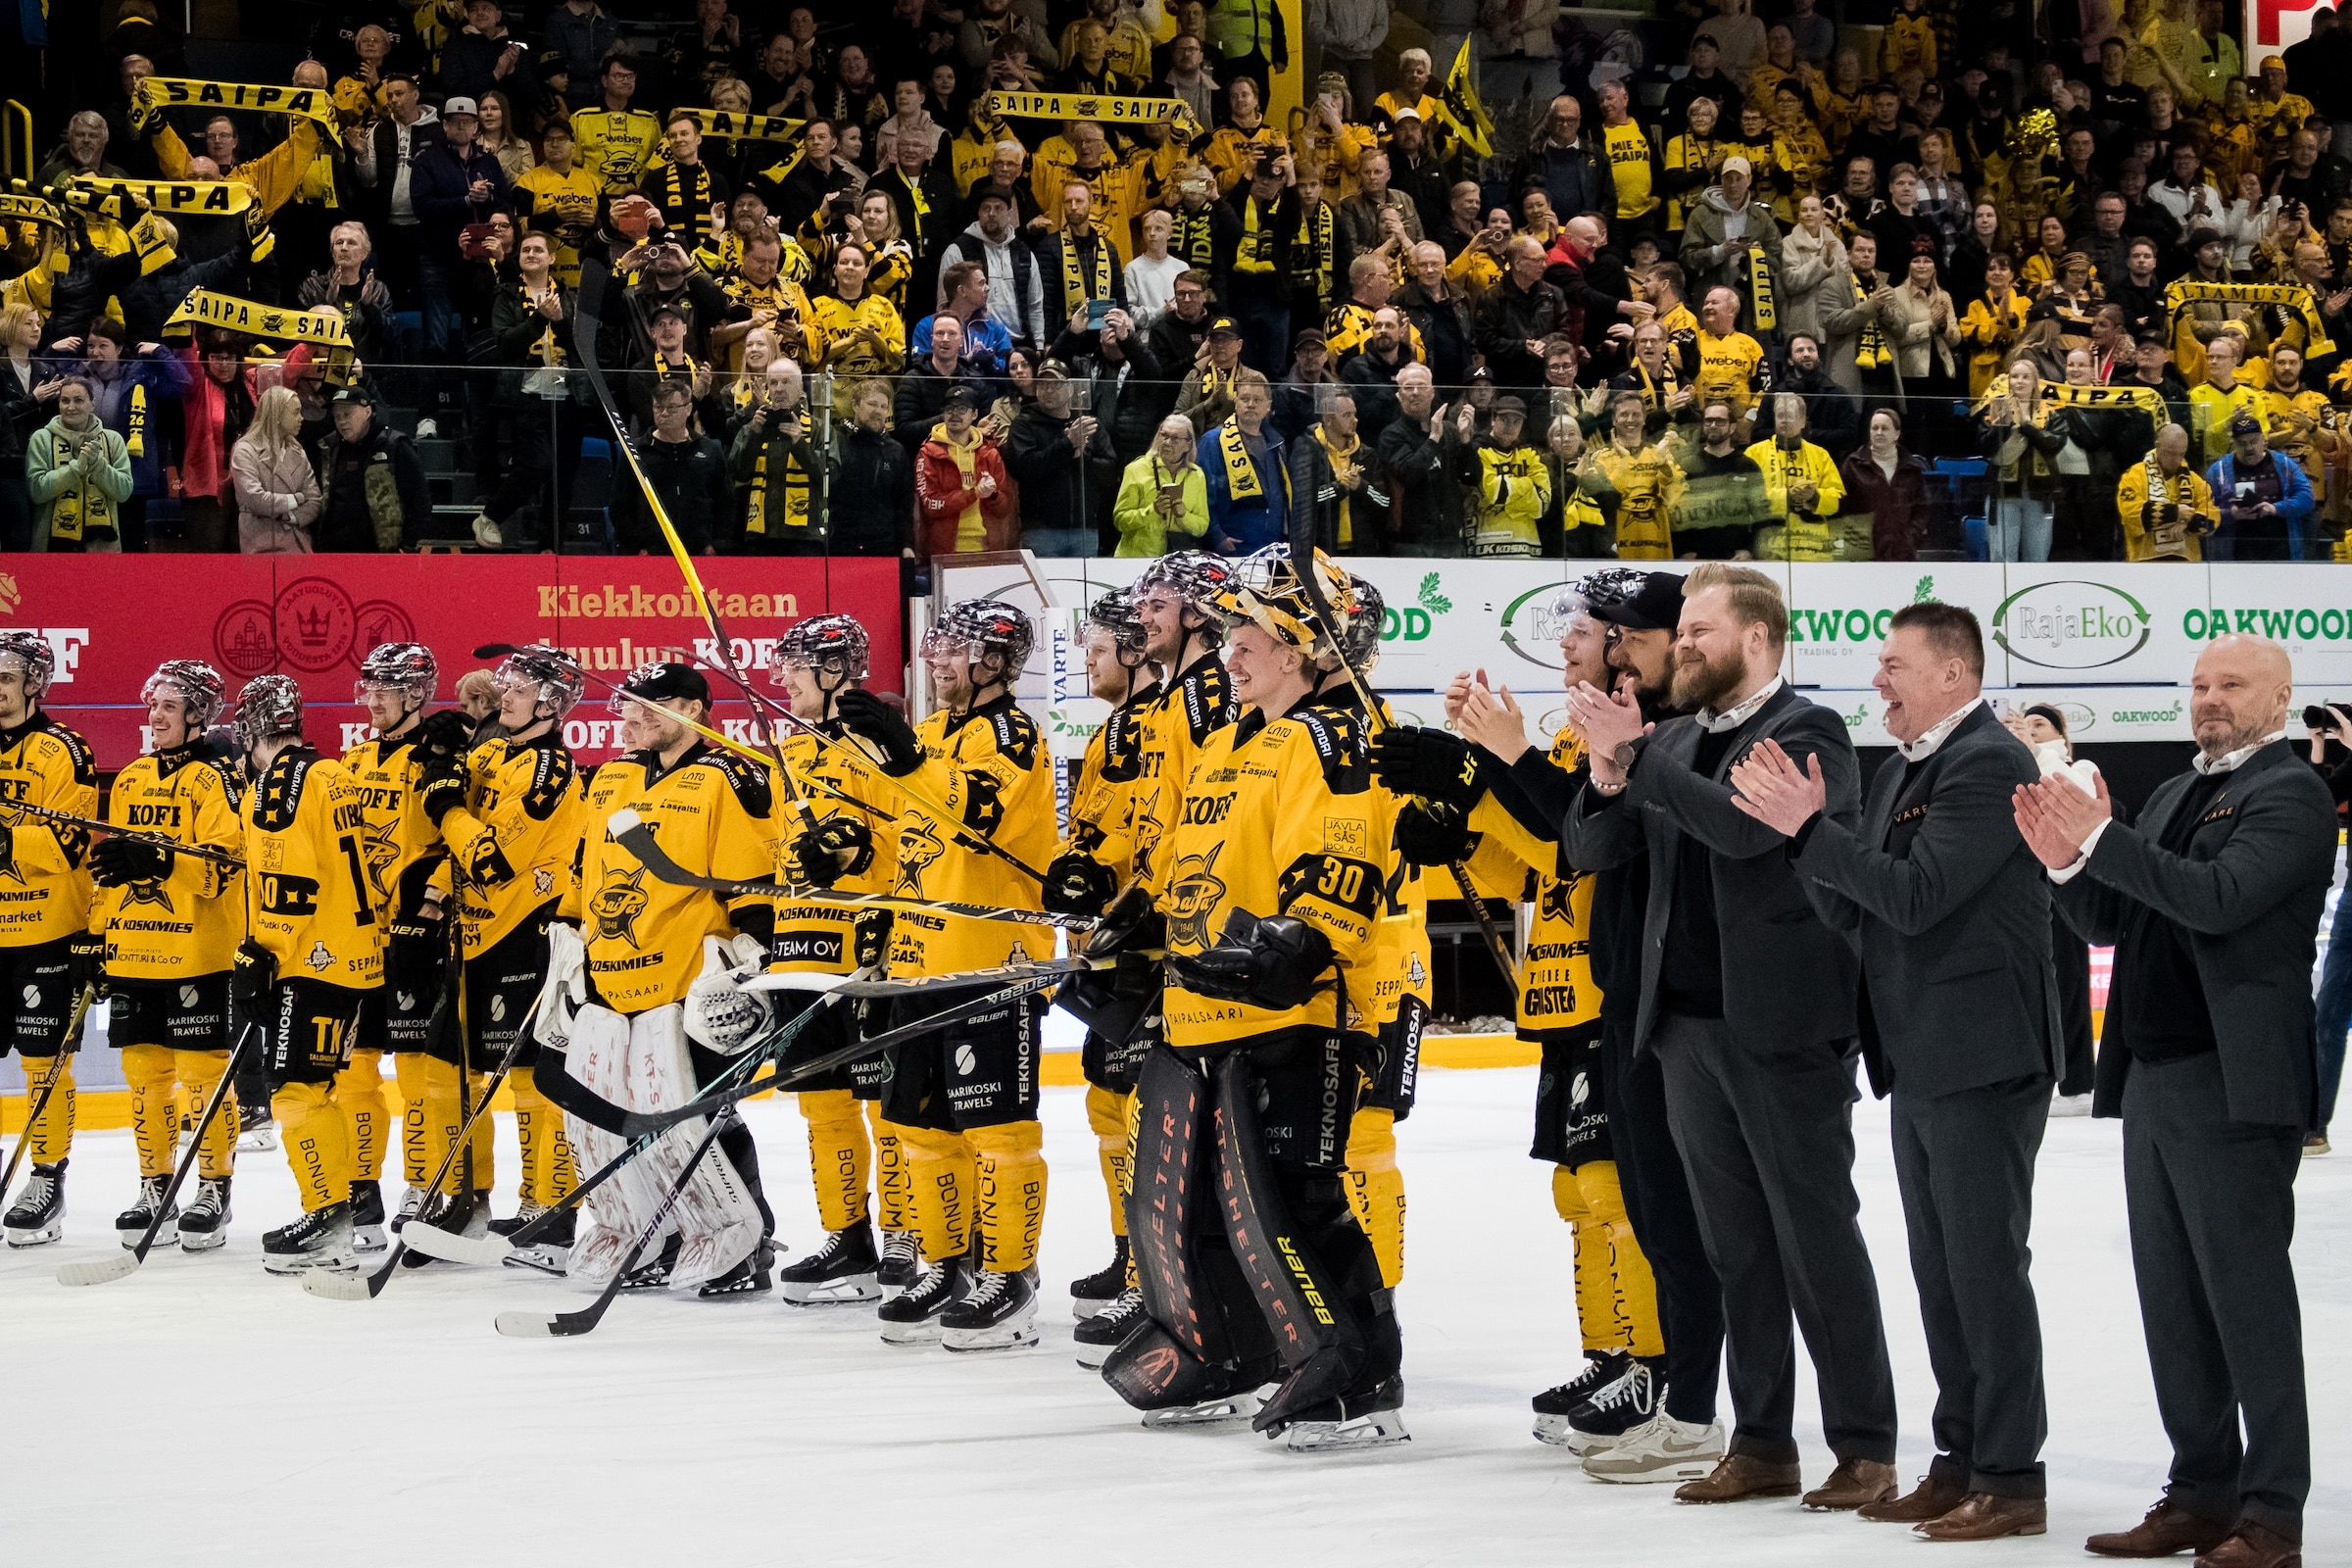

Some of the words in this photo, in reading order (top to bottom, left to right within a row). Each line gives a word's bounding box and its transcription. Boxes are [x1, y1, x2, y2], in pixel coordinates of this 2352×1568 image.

[164, 81, 317, 115] SAIPA
[991, 96, 1061, 114] SAIPA
[1113, 101, 1182, 121] SAIPA
[605, 134, 644, 144] weber
[1611, 141, 1633, 152] MIE
[1610, 151, 1651, 164] SAIPA
[553, 192, 594, 205] weber
[1759, 252, 1773, 318] SAIPA
[184, 297, 249, 325] SAIPA
[1704, 356, 1748, 368] weber
[129, 415, 145, 426] 26
[577, 524, 590, 535] 31
[2019, 604, 2132, 649] RajaEko
[1798, 648, 1838, 657] TRADING
[1841, 648, 1854, 657] OY
[2113, 710, 2178, 723] OAKWOOD
[1306, 715, 1334, 758] HYUNDAI
[59, 732, 83, 766] HYUNDAI
[680, 771, 707, 783] LATO
[709, 757, 742, 791] HYUNDAI
[665, 803, 702, 815] asfaltti
[1180, 791, 1238, 826] KOFF
[1326, 817, 1365, 833] JÄVLA
[1334, 829, 1356, 844] SÅS
[1326, 842, 1364, 856] BOLAG
[1317, 856, 1365, 903] 30
[1459, 868, 1491, 922] BAUER
[122, 919, 194, 934] KOSKIMIES
[281, 920, 295, 934] Oy
[604, 920, 618, 930] 1948
[1179, 921, 1195, 933] 1948
[1289, 904, 1356, 934] Ranta-Putki
[813, 940, 841, 958] OY
[35, 963, 70, 975] BAUER
[150, 955, 159, 964] &
[170, 956, 184, 965] OY
[303, 955, 337, 966] PLAYOFFS
[501, 972, 537, 983] BAUER
[167, 1015, 220, 1027] SAARIKOSKI
[967, 1008, 1009, 1026] BAUER
[1169, 1007, 1244, 1026] TAIPALSAARI
[173, 1026, 212, 1037] TRAVELS
[391, 1030, 427, 1040] TRAVELS
[48, 1050, 67, 1085] BAUER
[947, 1081, 1003, 1100] SAARIKOSKI
[954, 1096, 994, 1112] TRAVELS
[1318, 1038, 1341, 1164] TEKNOSAFE
[355, 1111, 372, 1178] BONUM
[408, 1098, 426, 1184] BONUM
[1123, 1097, 1145, 1198] BAUER
[515, 1110, 538, 1200] BONUM
[551, 1129, 567, 1199] BONUM
[299, 1137, 333, 1204] BONUM
[837, 1148, 859, 1222] BONUM
[880, 1136, 905, 1231] BONUM
[937, 1171, 965, 1250] BONUM
[1023, 1180, 1042, 1261] BONUM
[1276, 1236, 1337, 1326] BAUER
